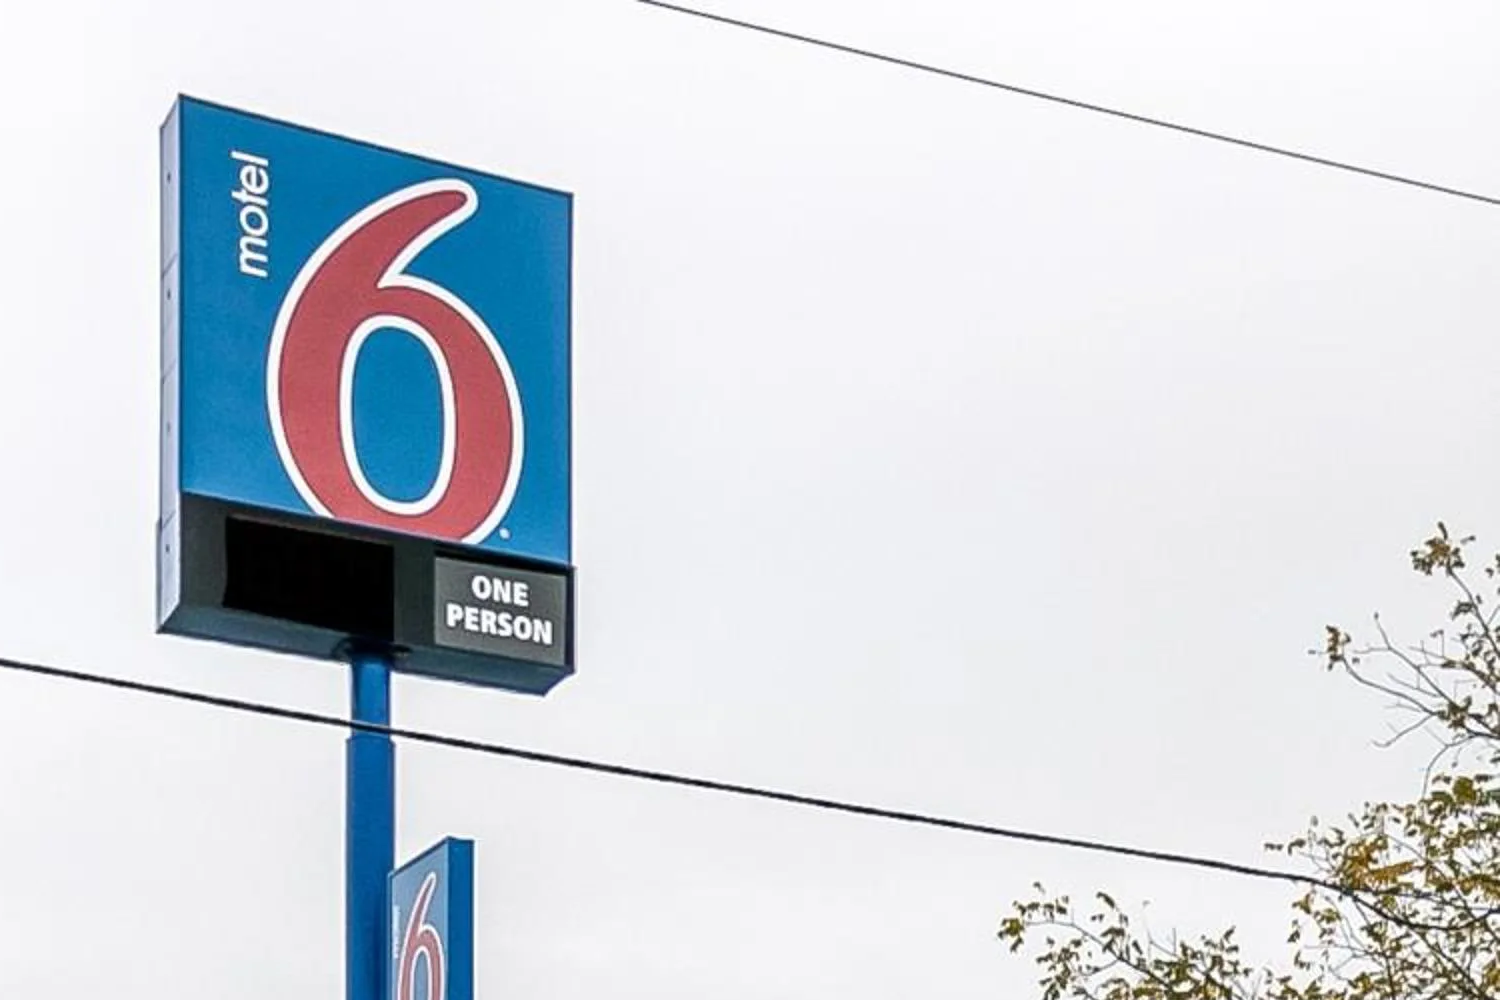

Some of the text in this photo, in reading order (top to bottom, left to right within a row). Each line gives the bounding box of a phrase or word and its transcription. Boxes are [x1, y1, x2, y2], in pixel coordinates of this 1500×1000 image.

[231, 151, 269, 277] motel
[266, 178, 525, 545] 6
[446, 603, 553, 645] PERSON
[471, 575, 529, 607] ONE
